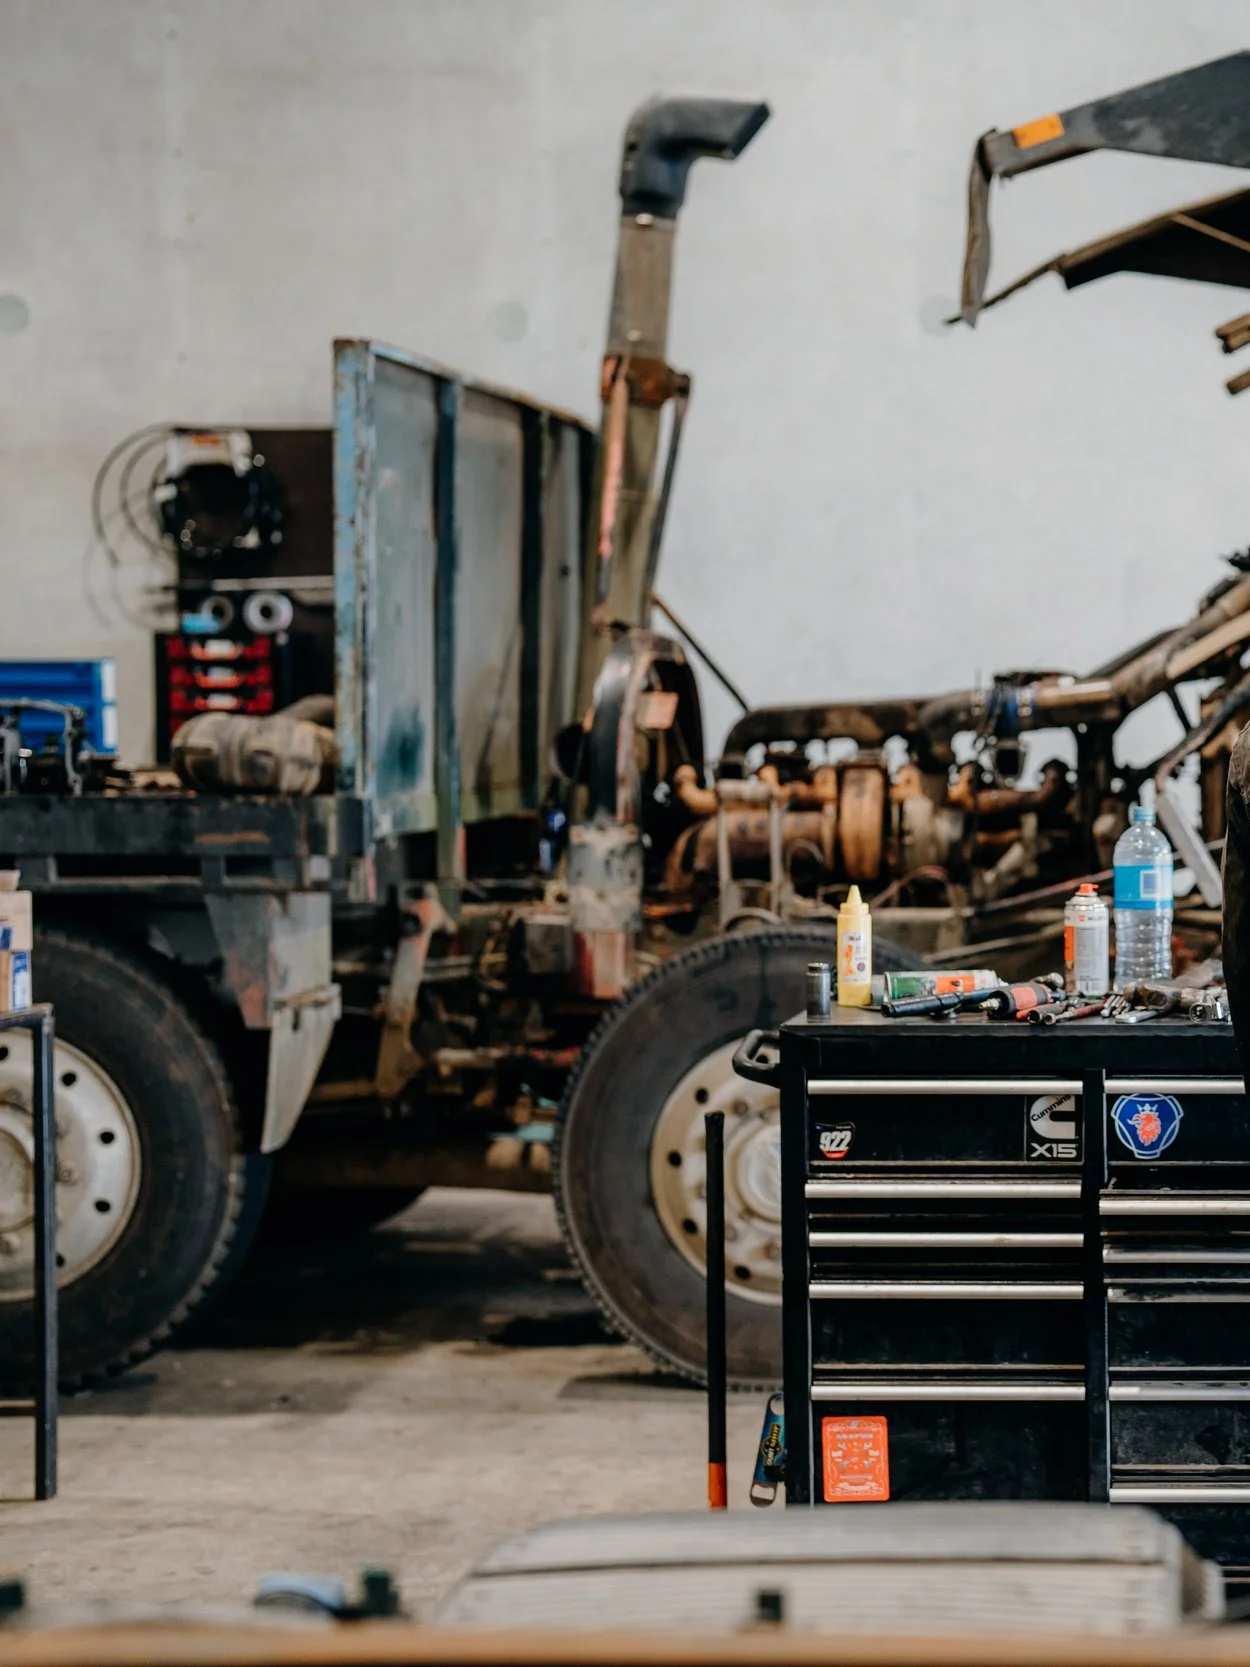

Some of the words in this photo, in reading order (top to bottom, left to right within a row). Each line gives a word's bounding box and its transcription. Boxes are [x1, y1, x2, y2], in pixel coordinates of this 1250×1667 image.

[1030, 1094, 1072, 1122] Cummins
[819, 1130, 851, 1152] 922
[1030, 1143, 1078, 1159] X15
